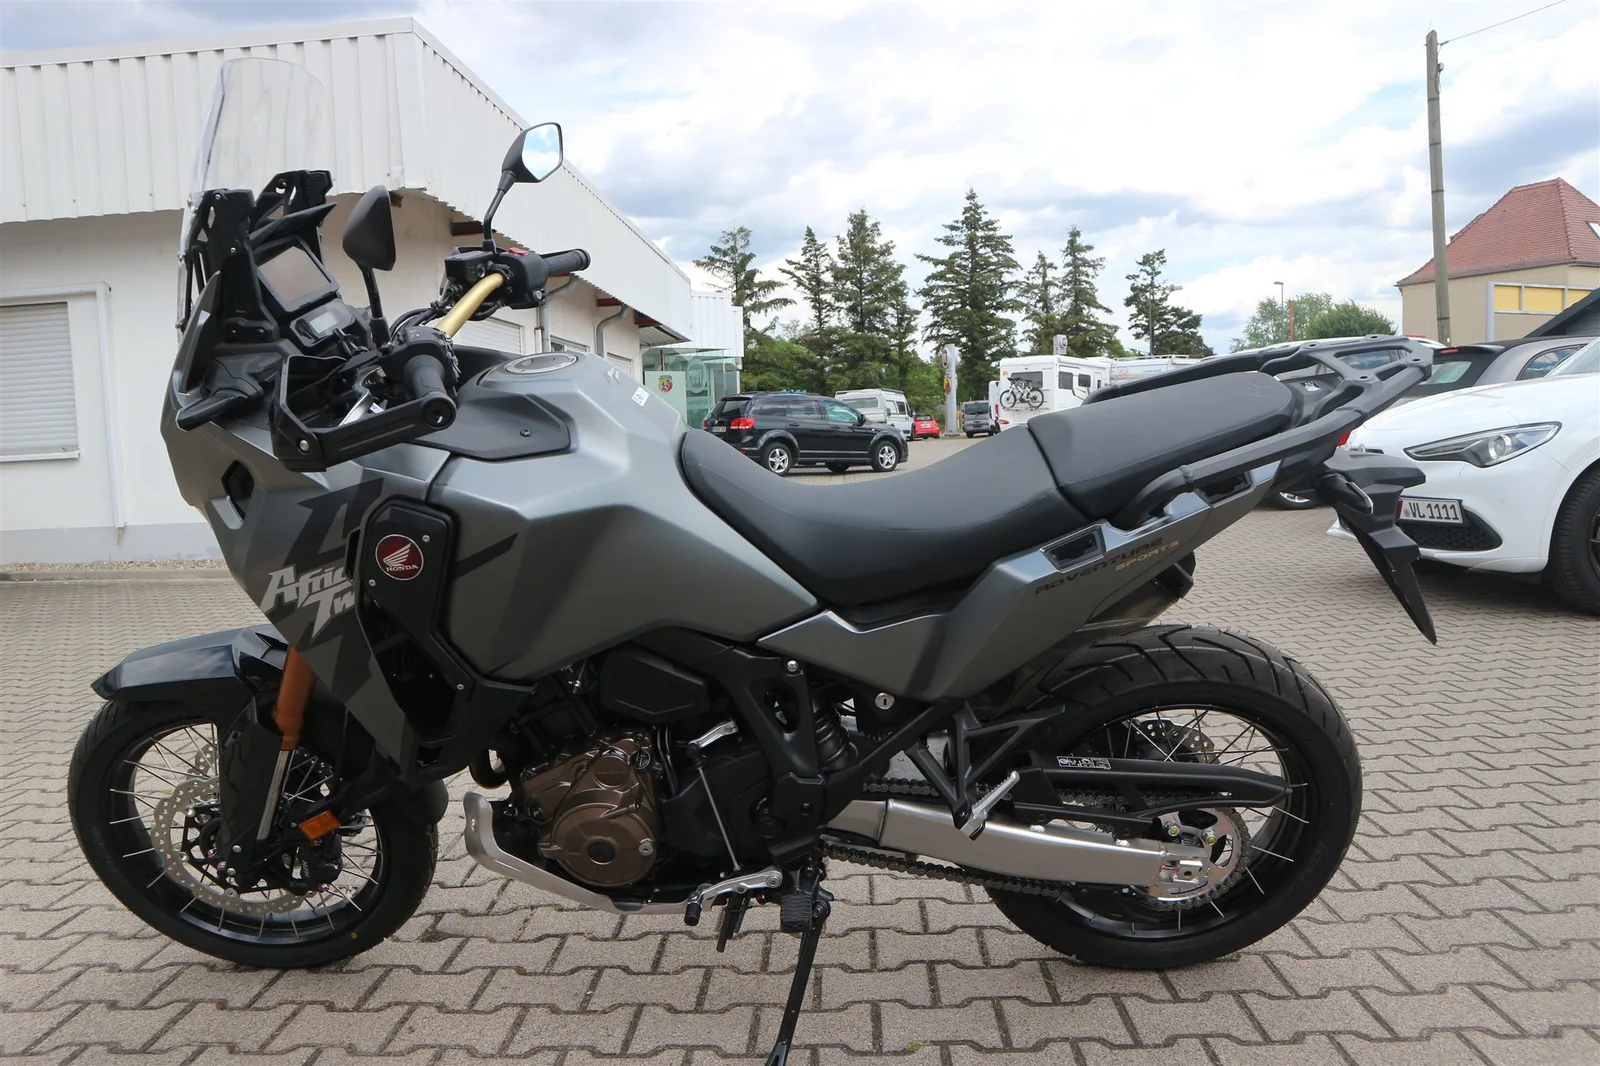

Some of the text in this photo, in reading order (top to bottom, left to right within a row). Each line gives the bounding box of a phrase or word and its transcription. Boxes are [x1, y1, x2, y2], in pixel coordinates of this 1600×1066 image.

[1408, 501, 1460, 520] VL 1111
[385, 564, 419, 572] HONDA
[1035, 537, 1164, 594] ADVENTURE
[1114, 539, 1180, 572] SPORTS
